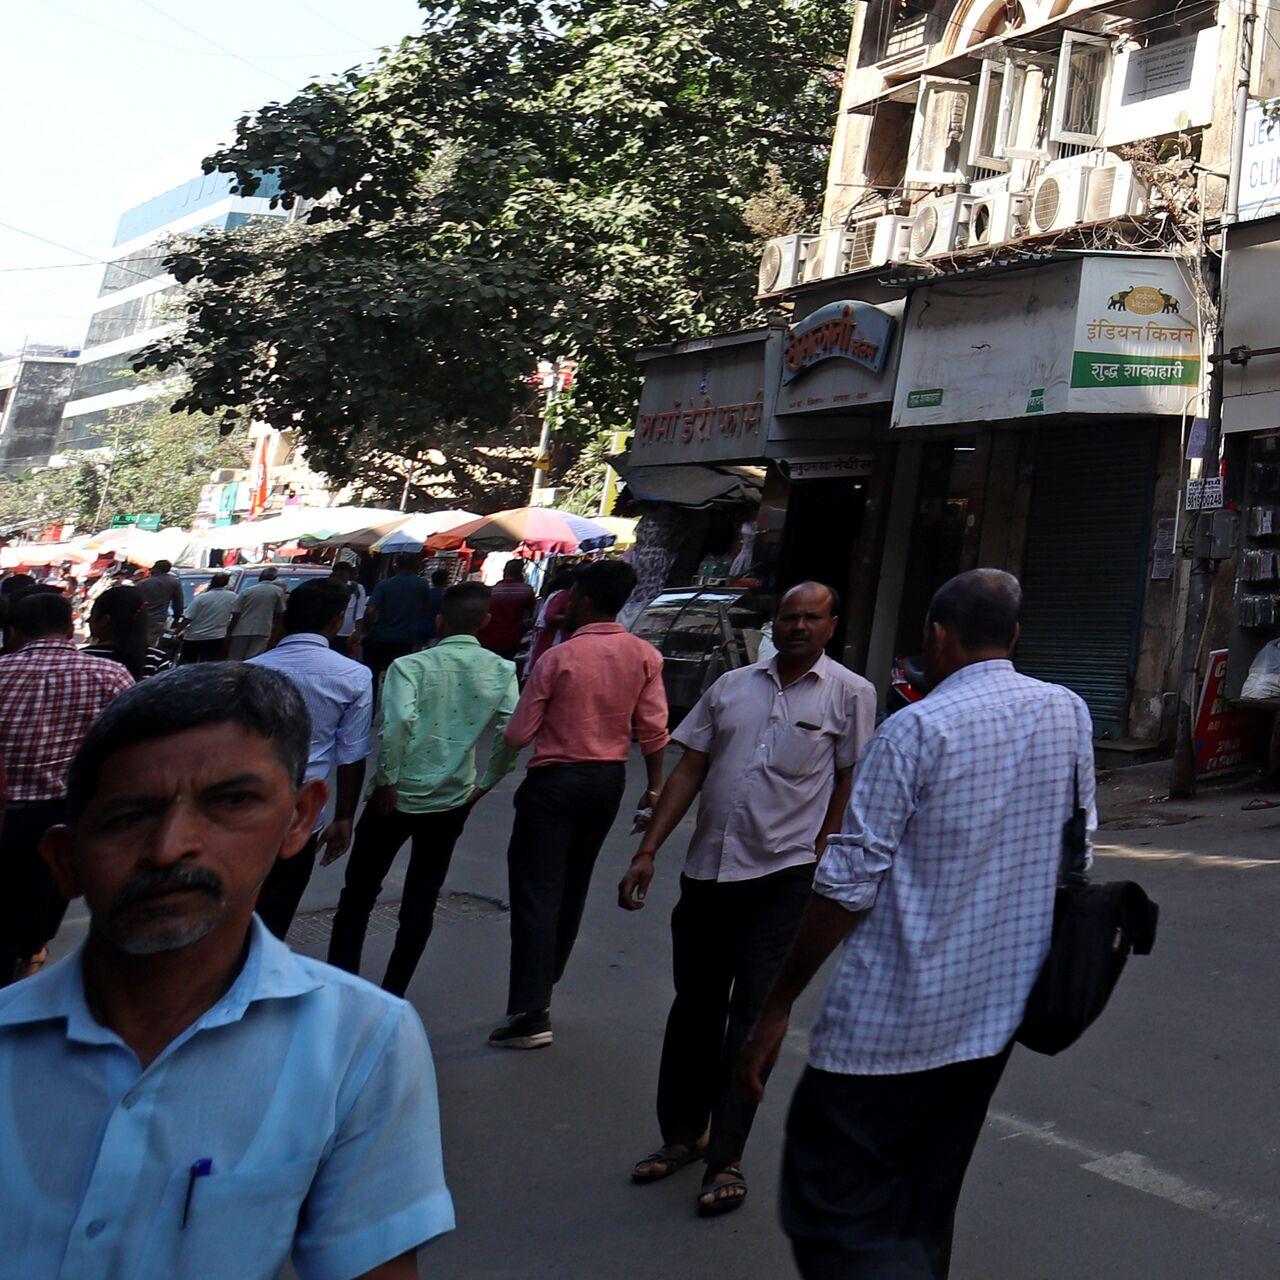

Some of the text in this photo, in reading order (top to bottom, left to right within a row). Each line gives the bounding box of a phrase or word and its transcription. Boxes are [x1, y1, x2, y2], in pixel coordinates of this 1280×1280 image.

[1087, 318, 1196, 343] इंडियन किचन
[1090, 361, 1184, 381] शुद्ध शाकाहारी
